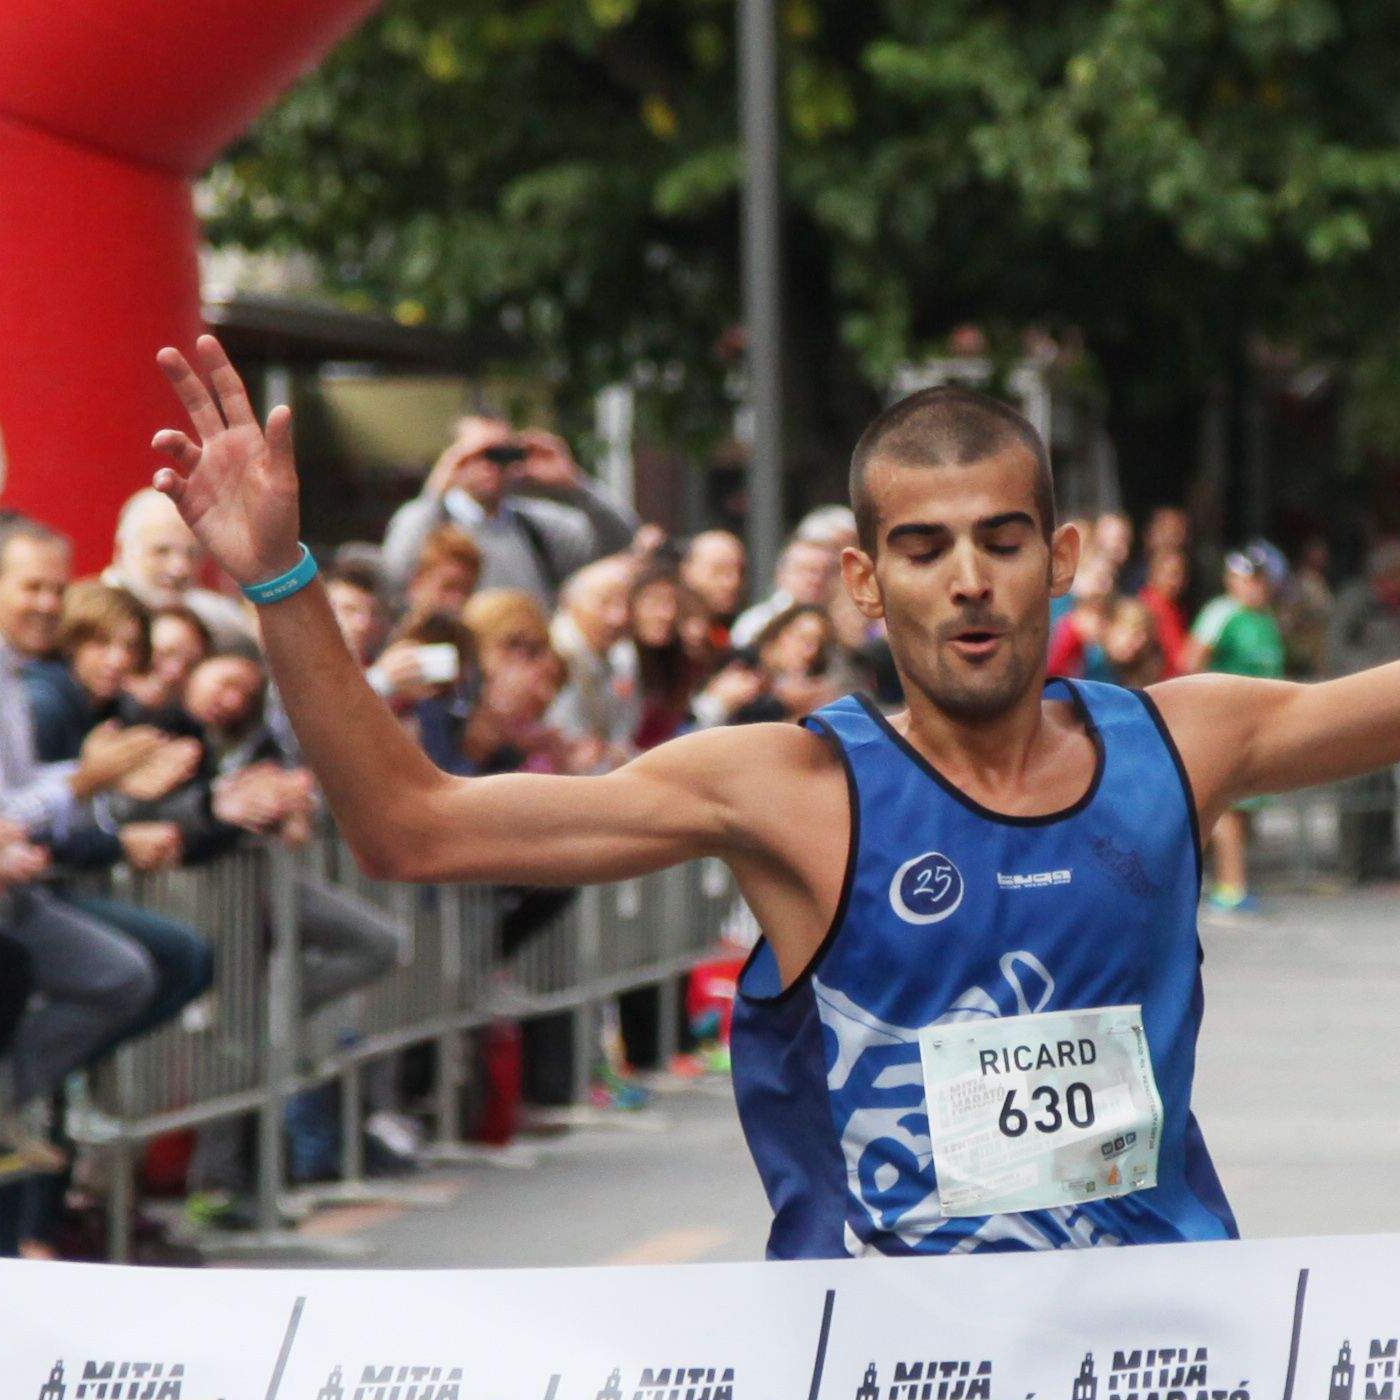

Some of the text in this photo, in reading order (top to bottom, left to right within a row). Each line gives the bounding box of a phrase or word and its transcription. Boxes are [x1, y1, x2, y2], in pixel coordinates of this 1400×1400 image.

[913, 865, 952, 902] 25
[979, 1038, 1096, 1075] RICARD
[998, 1082, 1095, 1138] 630
[75, 1361, 185, 1400] MITJA
[888, 1361, 992, 1400] MITJA
[1108, 1348, 1207, 1390] MITJA
